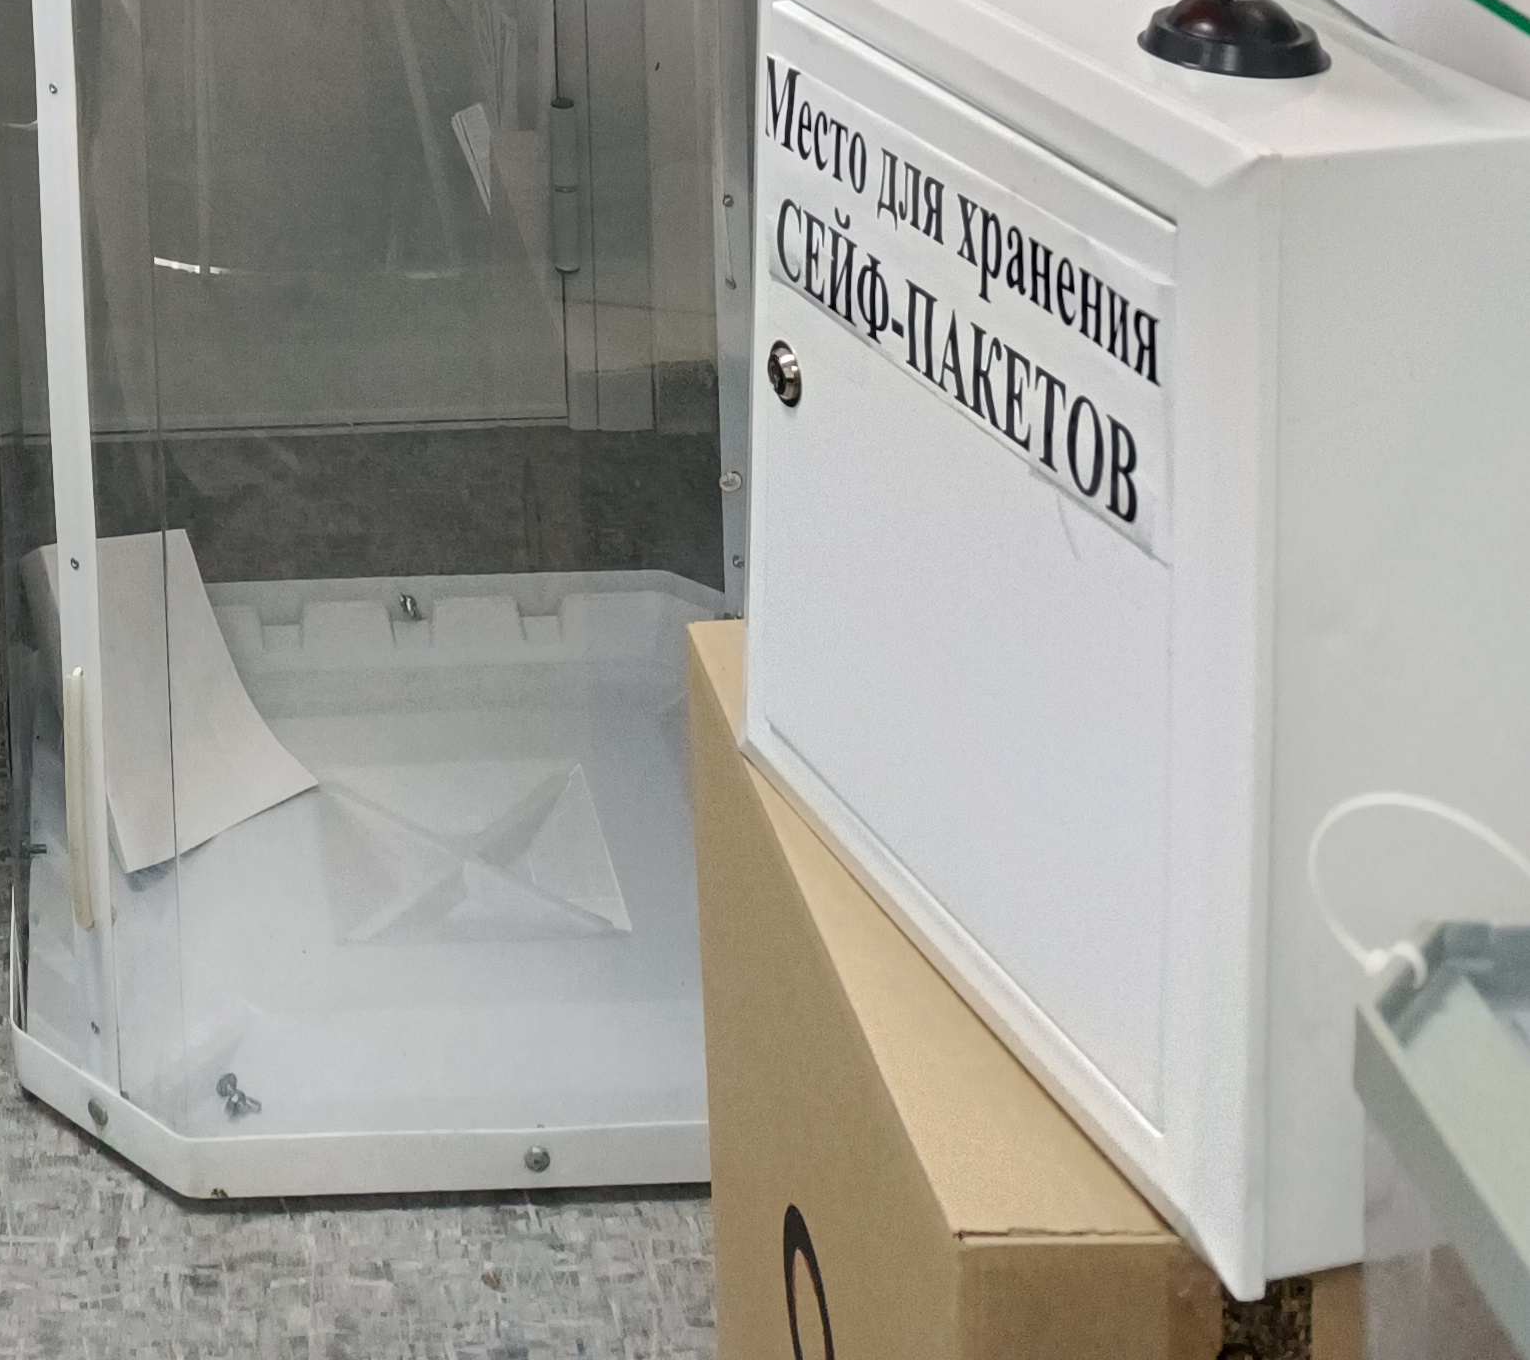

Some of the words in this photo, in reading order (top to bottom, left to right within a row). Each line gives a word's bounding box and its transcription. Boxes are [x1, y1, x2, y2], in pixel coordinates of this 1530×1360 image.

[764, 54, 869, 197] Место
[876, 147, 946, 248] для
[957, 192, 1164, 388] хранения
[775, 197, 1140, 526] СЕЙФ-ПАКЕТОВ
